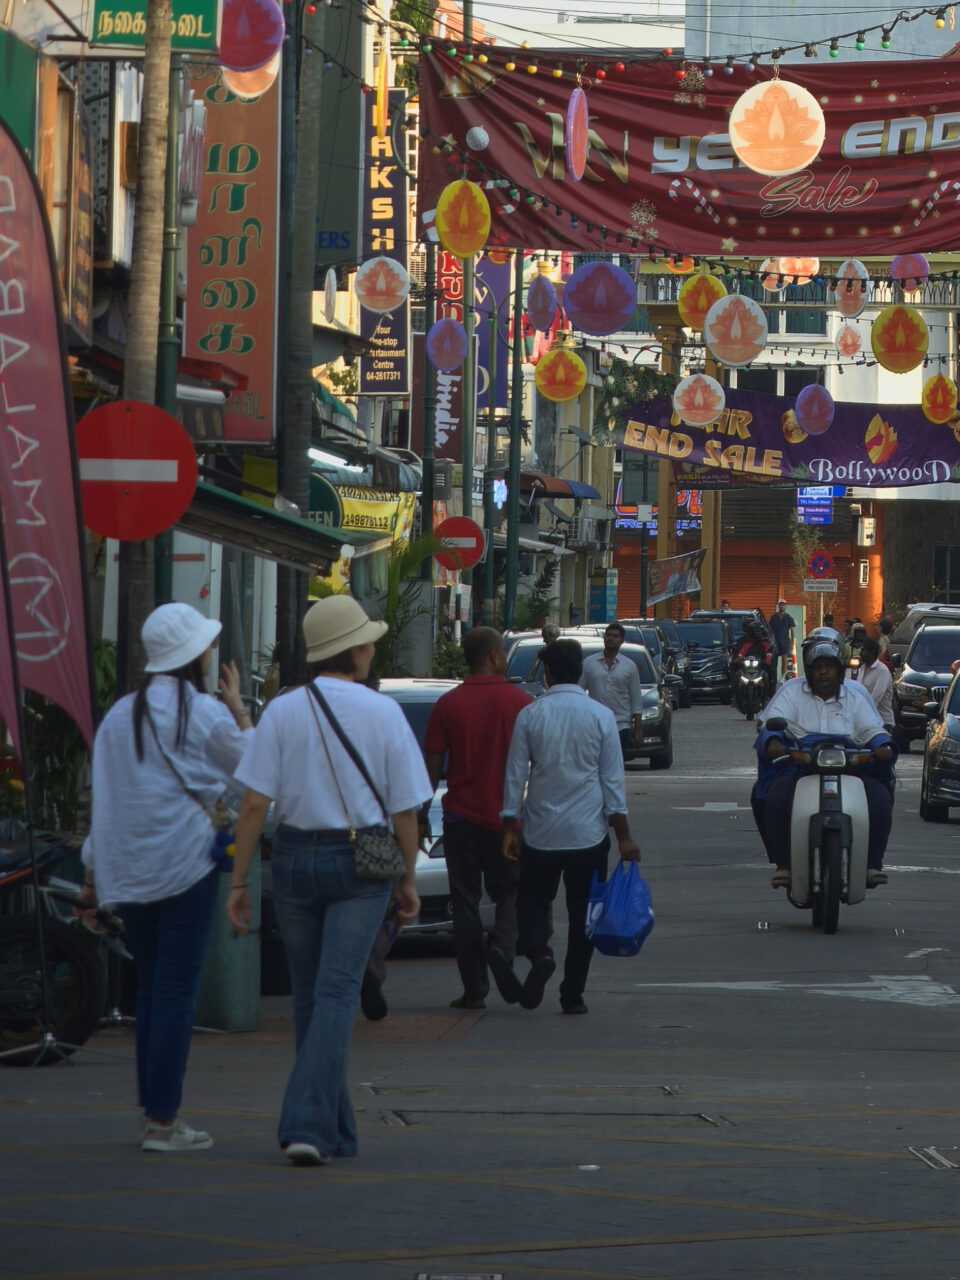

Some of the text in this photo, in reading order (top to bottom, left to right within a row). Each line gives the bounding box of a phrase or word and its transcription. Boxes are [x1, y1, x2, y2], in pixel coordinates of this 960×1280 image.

[759, 165, 878, 218] Sale
[369, 348, 406, 358] tertainment
[373, 360, 395, 369] Centre
[623, 421, 694, 459] END
[702, 439, 784, 477] SALE
